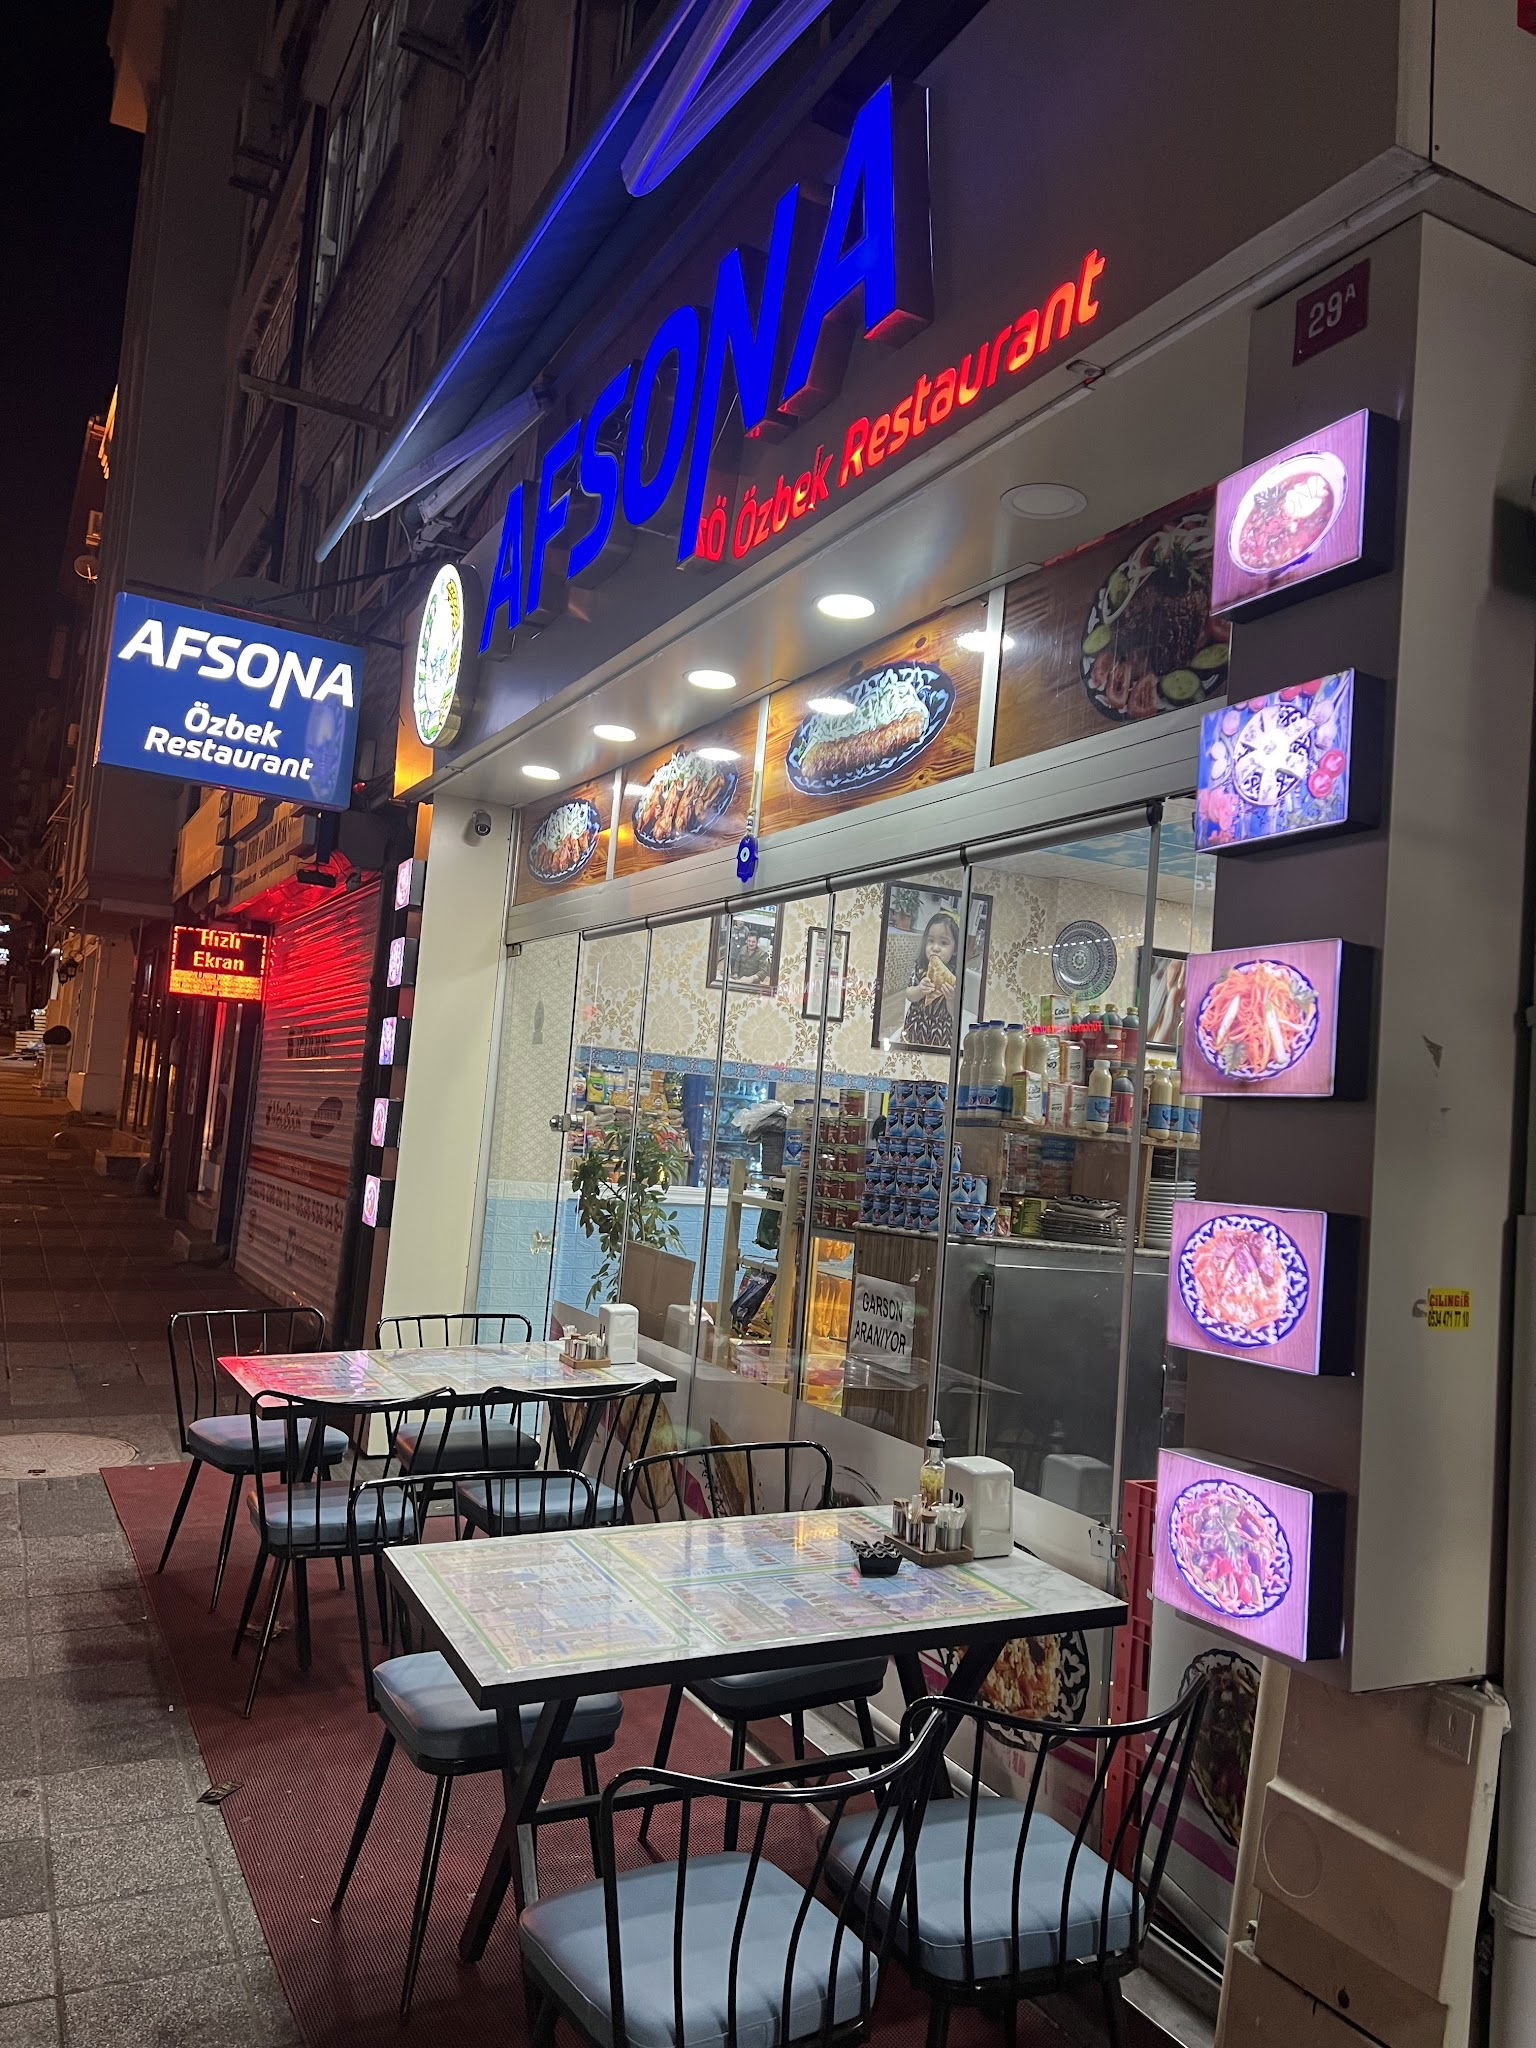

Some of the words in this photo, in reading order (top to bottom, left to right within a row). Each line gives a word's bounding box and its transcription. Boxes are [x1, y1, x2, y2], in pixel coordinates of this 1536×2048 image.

[477, 80, 897, 654] AFSONA
[734, 444, 834, 559] Özbek
[838, 248, 1106, 488] Restaurant
[118, 619, 355, 708] AFSONA
[184, 701, 282, 748] Özbek
[144, 726, 314, 781] Restaurant
[193, 951, 245, 972] Ekran
[862, 1292, 904, 1322] GARSON
[854, 1320, 907, 1355] ARANIYOR
